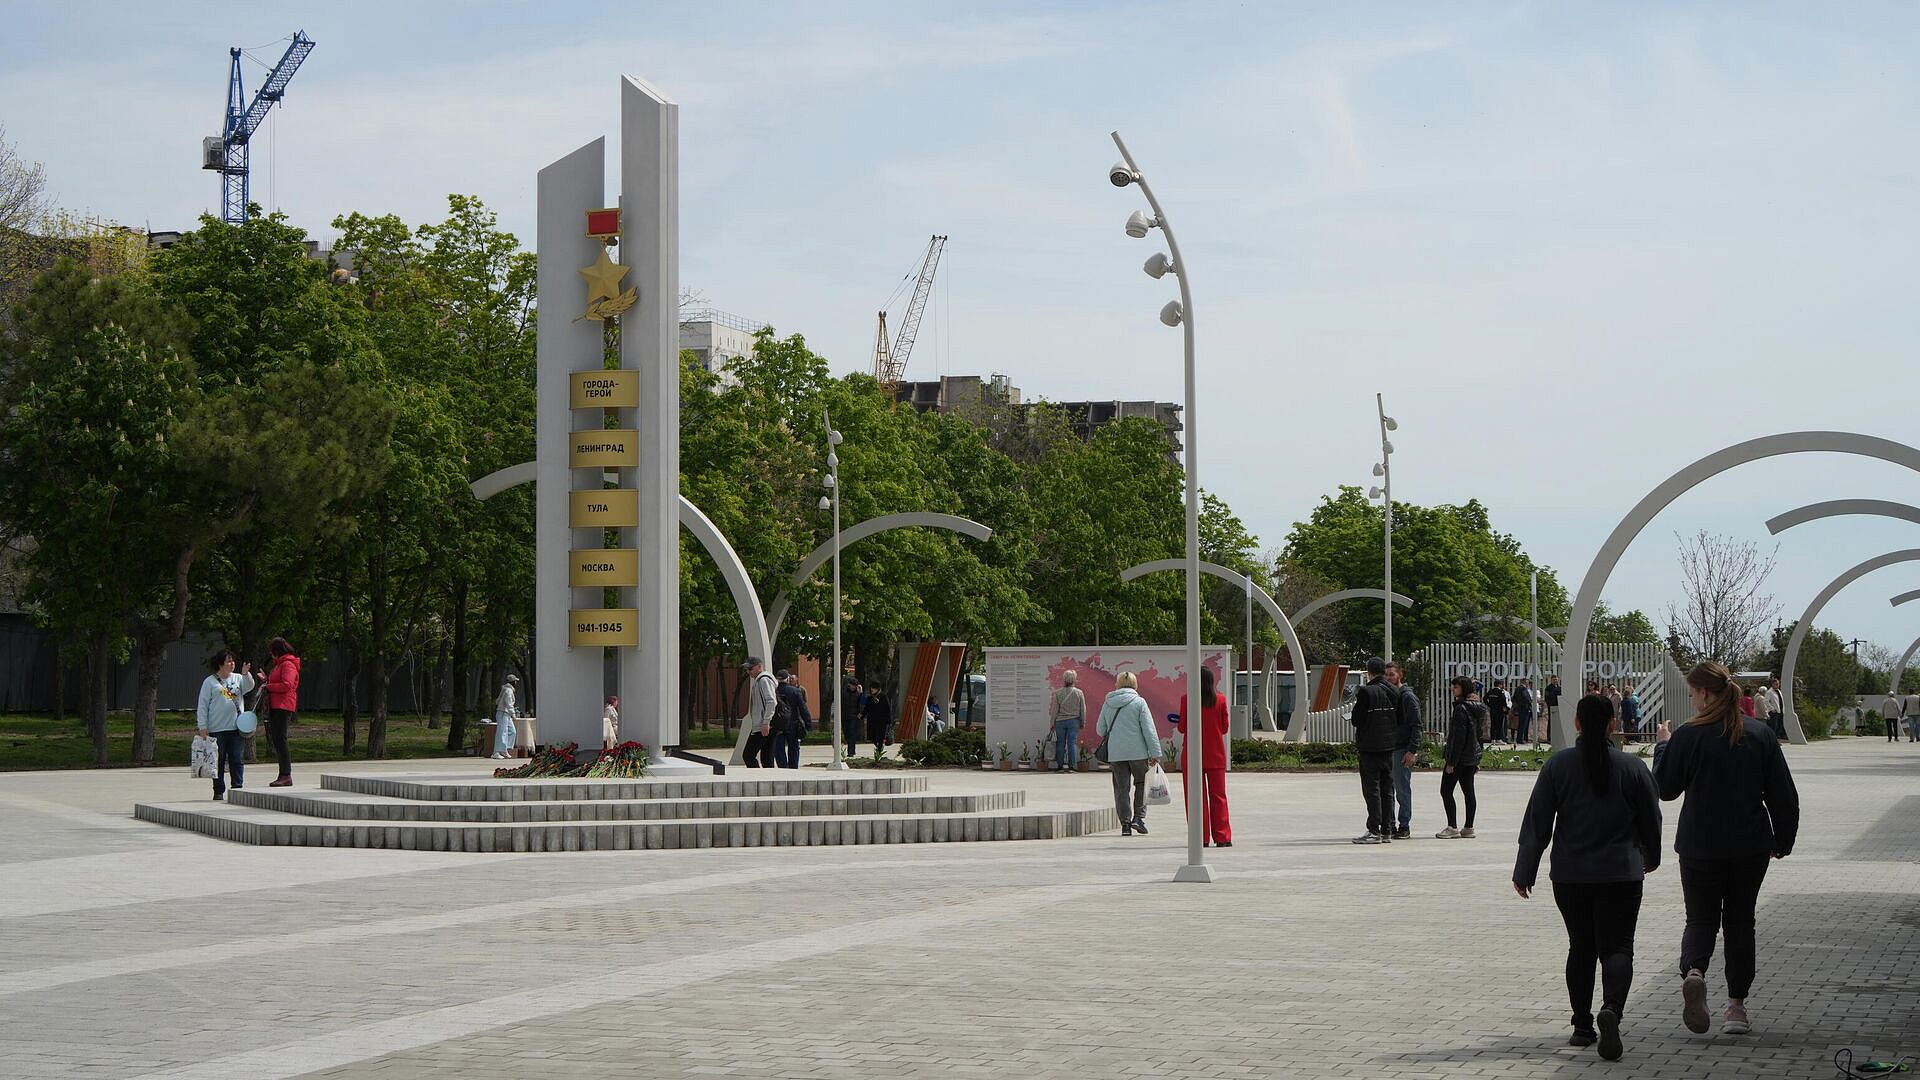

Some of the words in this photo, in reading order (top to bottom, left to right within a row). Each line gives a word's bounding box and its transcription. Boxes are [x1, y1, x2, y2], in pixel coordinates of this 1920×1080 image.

[583, 380, 620, 389] ГОРОДА-
[585, 389, 612, 398] ГЕРОИ
[576, 444, 625, 453] ЛЕНИНГРАД
[587, 504, 609, 512] ТУЛА
[581, 563, 615, 572] МОСКВА
[577, 622, 622, 632] 1941-1945
[1444, 661, 1633, 680] ГОРОДА-ГРОИ
